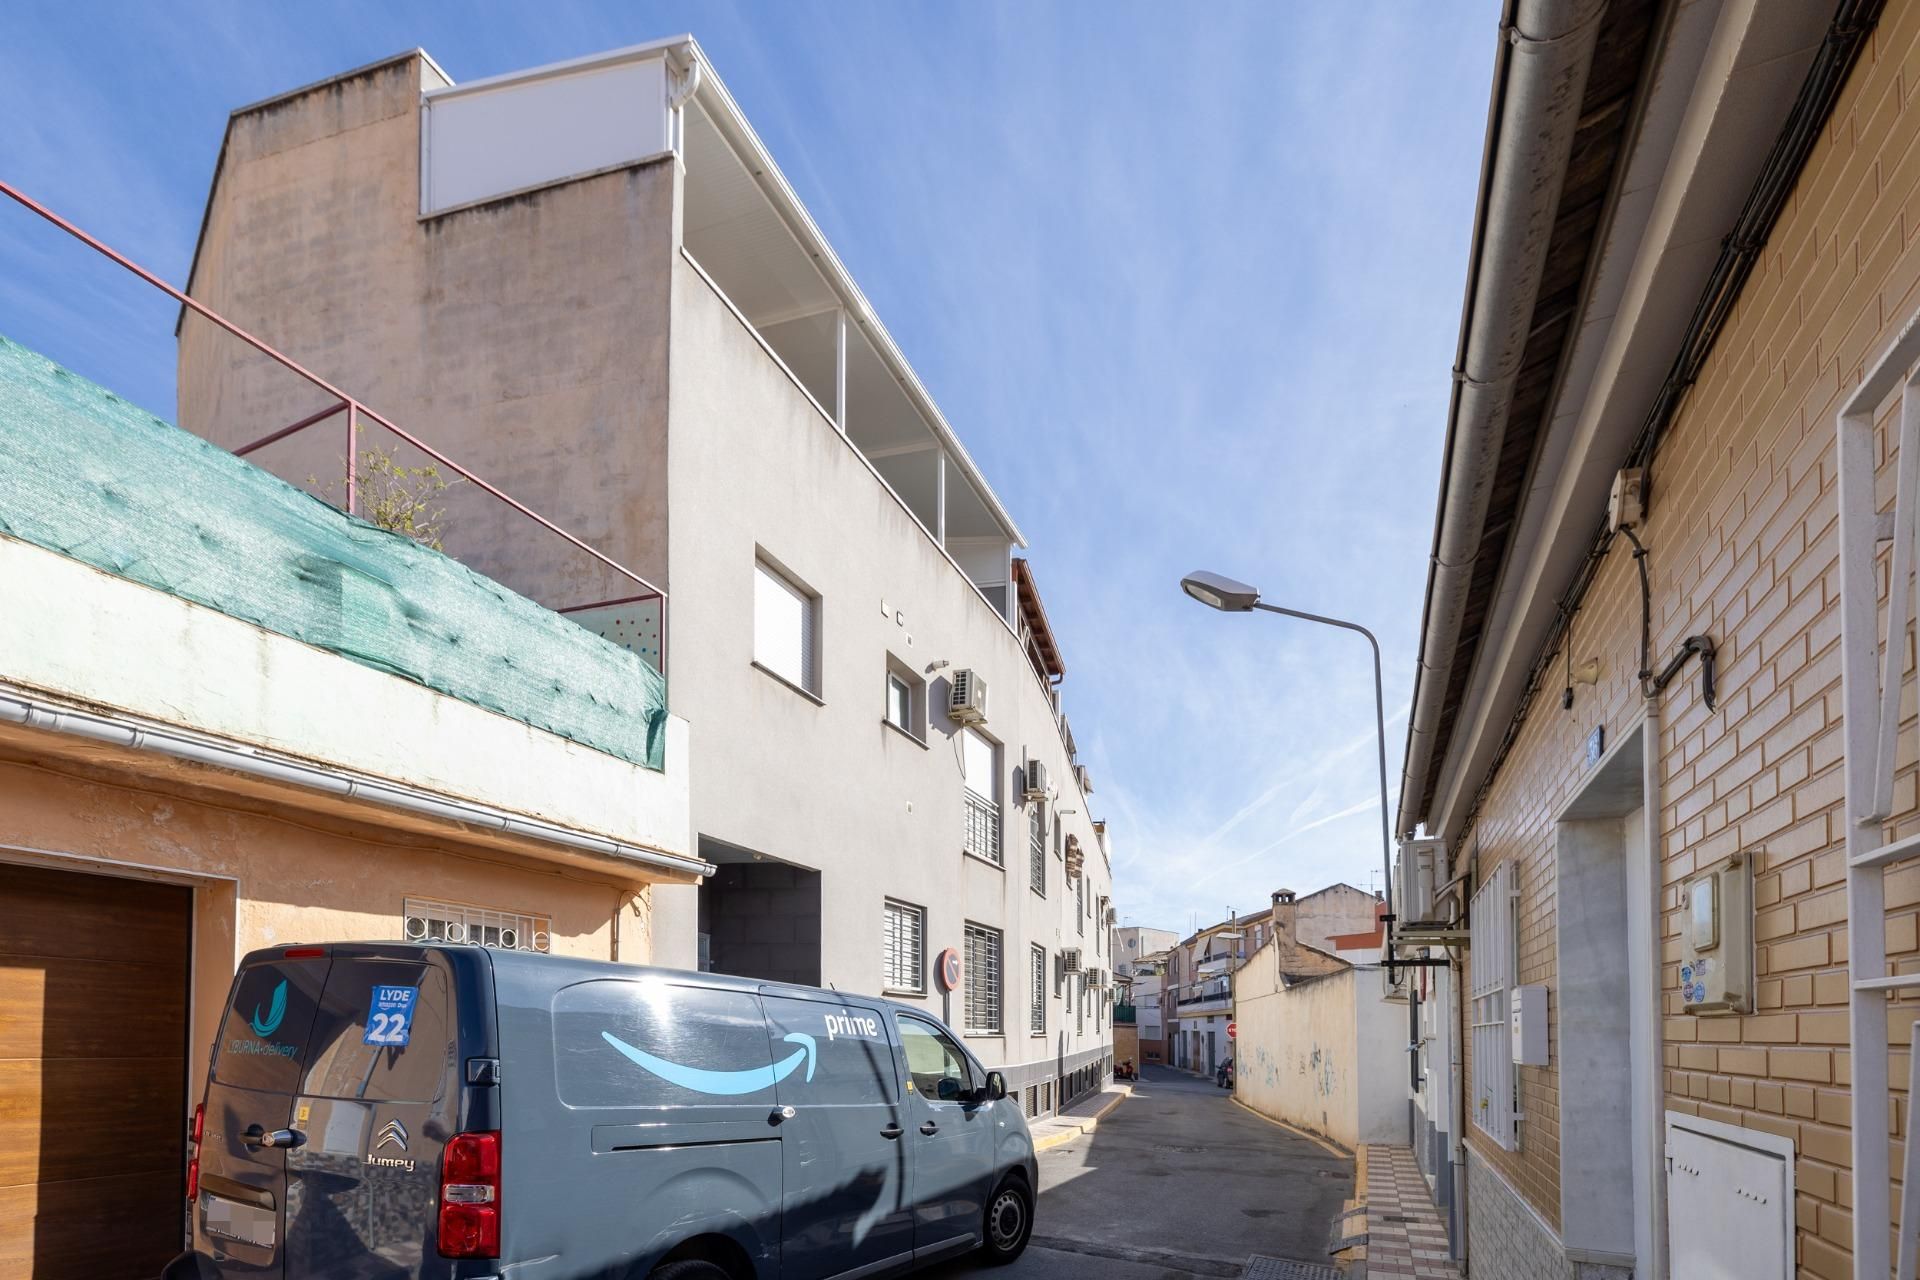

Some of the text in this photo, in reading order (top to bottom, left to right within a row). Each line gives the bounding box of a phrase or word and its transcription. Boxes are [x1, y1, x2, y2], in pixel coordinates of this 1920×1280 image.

[380, 989, 411, 1002] LYDE
[367, 1013, 406, 1042] 22
[824, 1009, 878, 1041] prime
[362, 1153, 415, 1172] Jumpy
